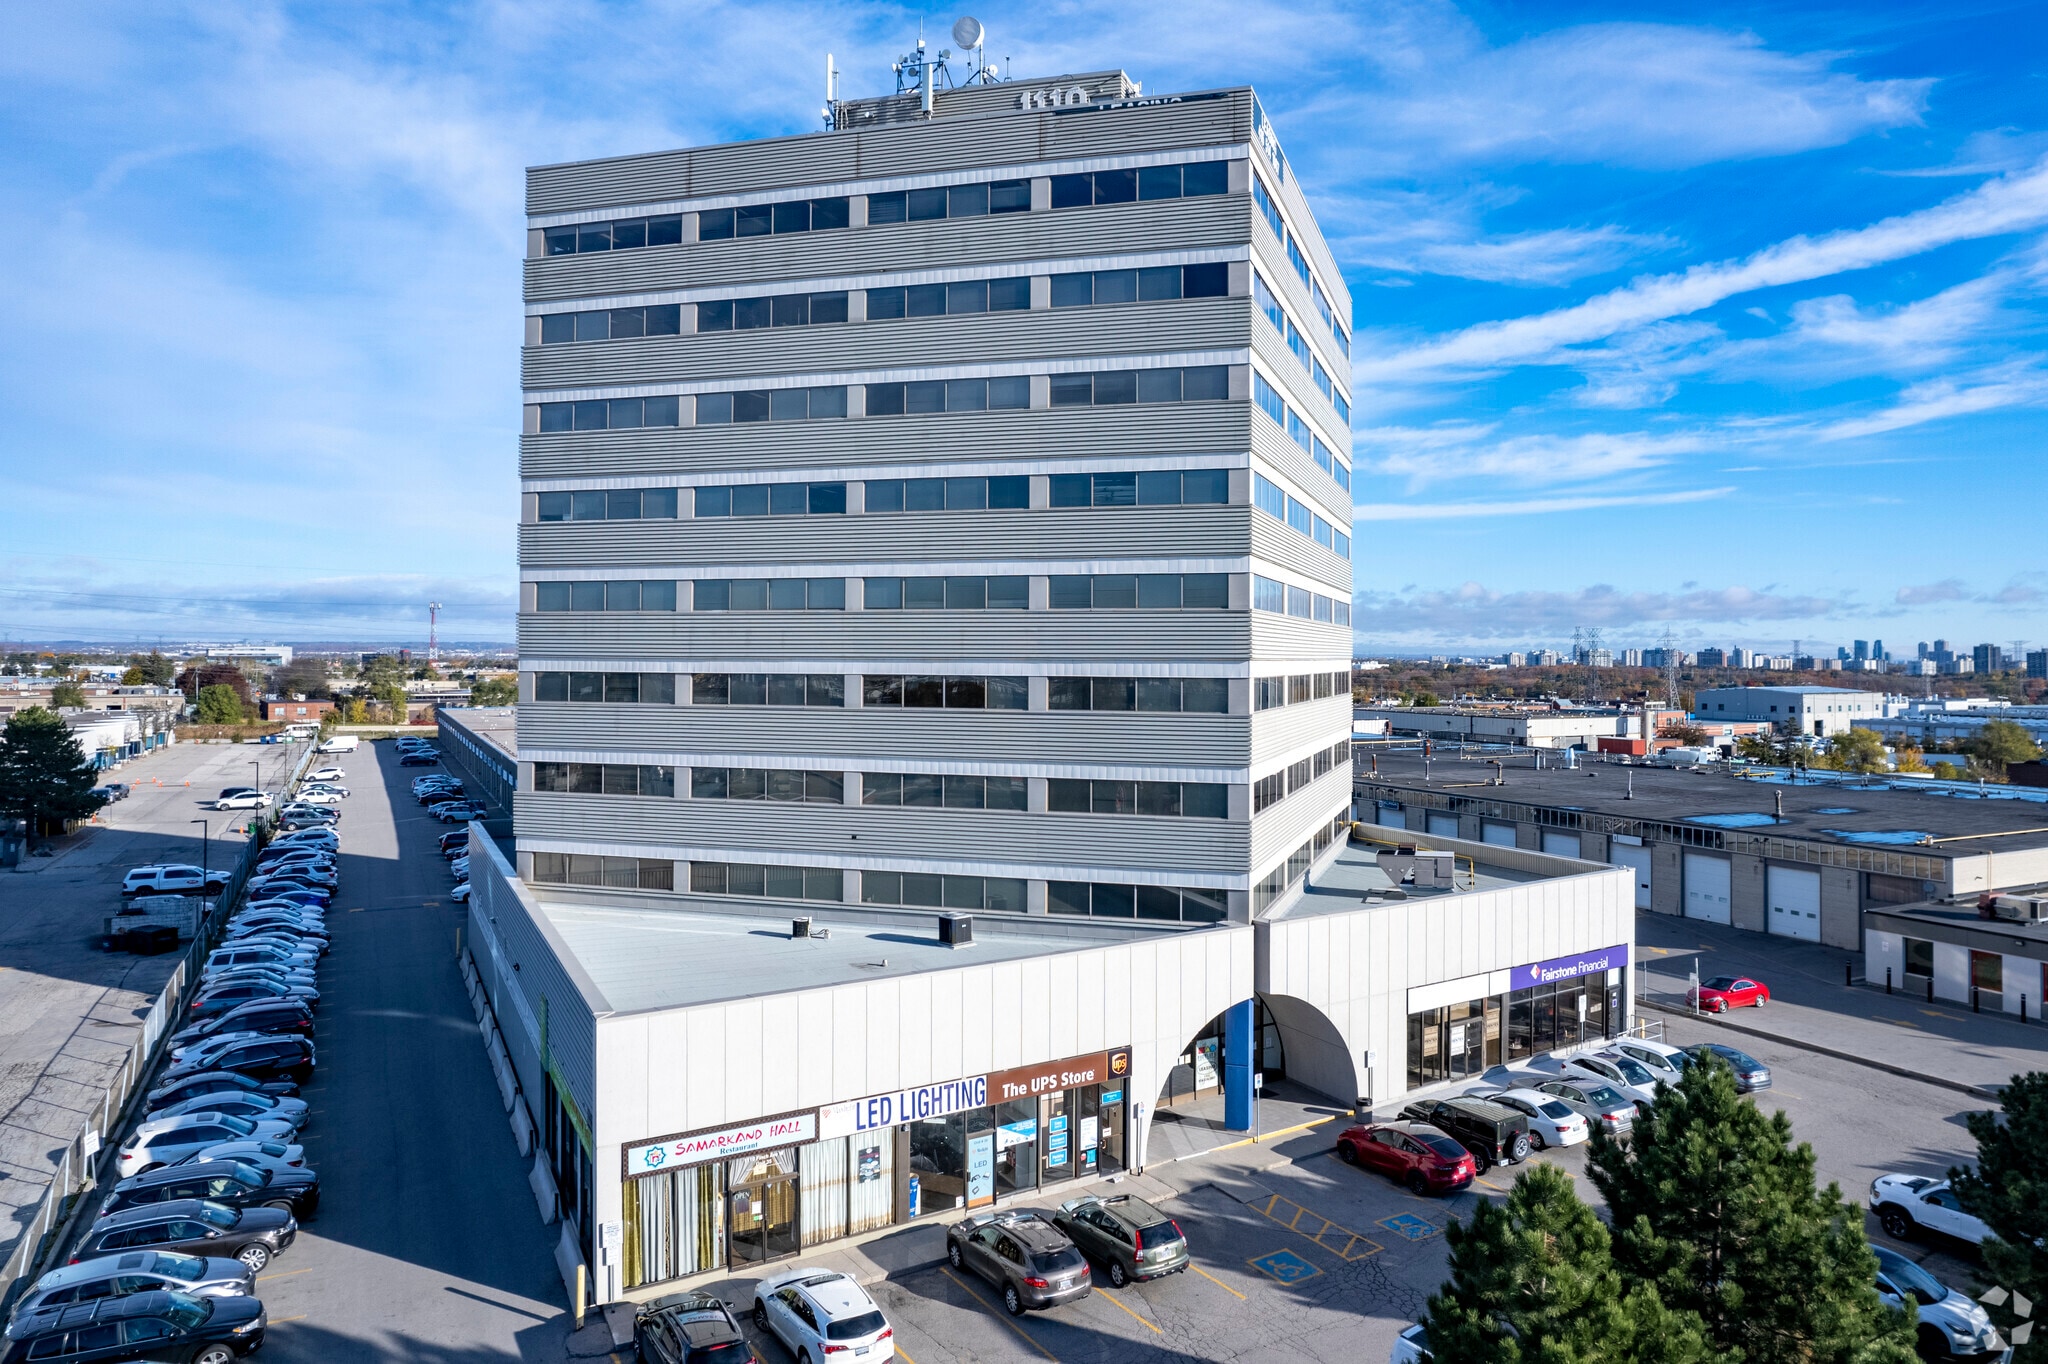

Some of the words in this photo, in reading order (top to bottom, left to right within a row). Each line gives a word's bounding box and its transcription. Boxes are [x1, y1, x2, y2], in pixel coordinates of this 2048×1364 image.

[1021, 85, 1089, 110] 1110
[1541, 965, 1577, 982] Fairstone
[1578, 956, 1609, 974] Financial
[1002, 1083, 1027, 1098] The
[1031, 1074, 1057, 1093] UPS
[1061, 1071, 1094, 1087] Store
[856, 1096, 892, 1131] LED
[900, 1077, 986, 1122] LIGHTING
[675, 1129, 763, 1155] SAMARKAND
[769, 1121, 801, 1137] HALL
[719, 1142, 758, 1155] Restaurant
